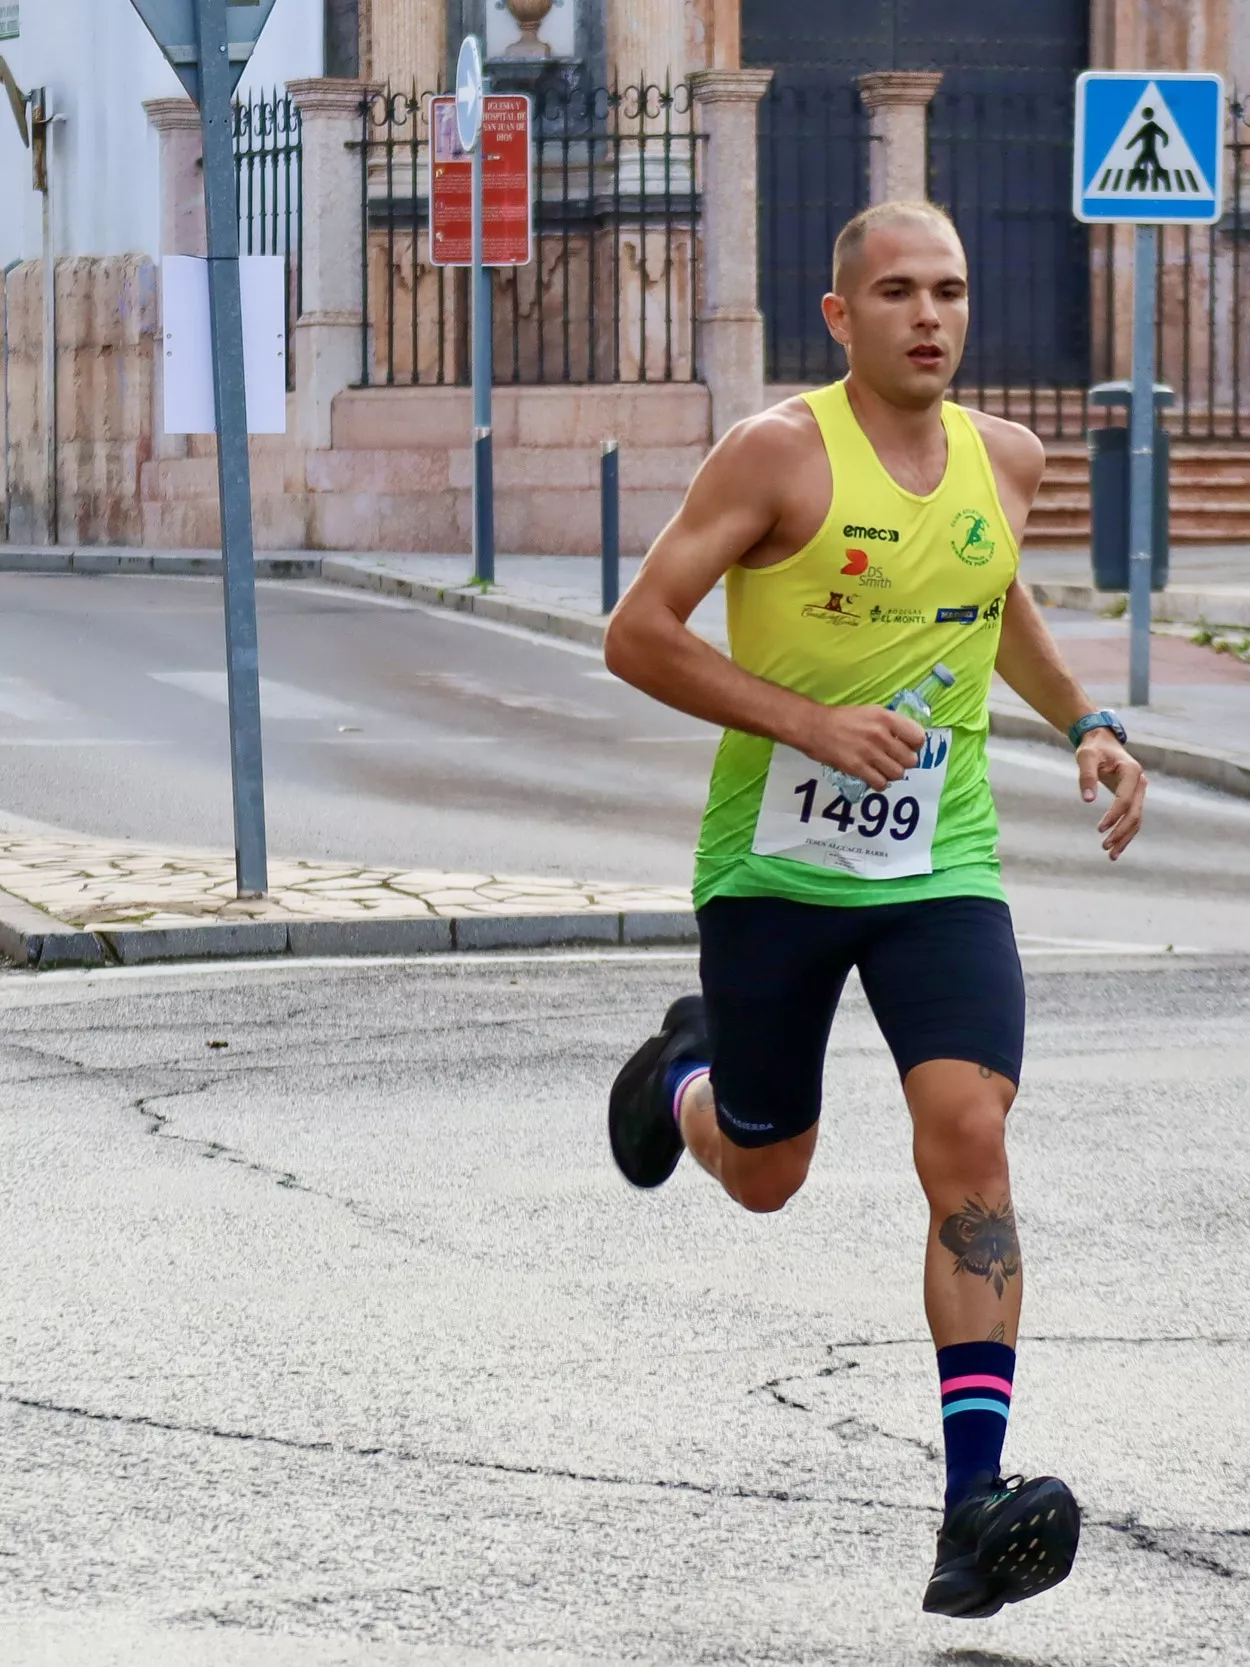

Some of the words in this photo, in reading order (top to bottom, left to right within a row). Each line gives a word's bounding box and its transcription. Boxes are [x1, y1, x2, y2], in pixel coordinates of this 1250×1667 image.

[488, 102, 514, 110] IGLESIA
[517, 112, 526, 120] DE
[483, 122, 496, 131] SAN
[498, 122, 515, 131] JUAN
[516, 122, 526, 131] DE
[497, 133, 512, 142] DIOS
[867, 566, 883, 579] DS
[858, 574, 892, 589] Smith
[881, 614, 892, 623] EL
[893, 615, 927, 624] MONTE
[794, 778, 920, 841] 1499
